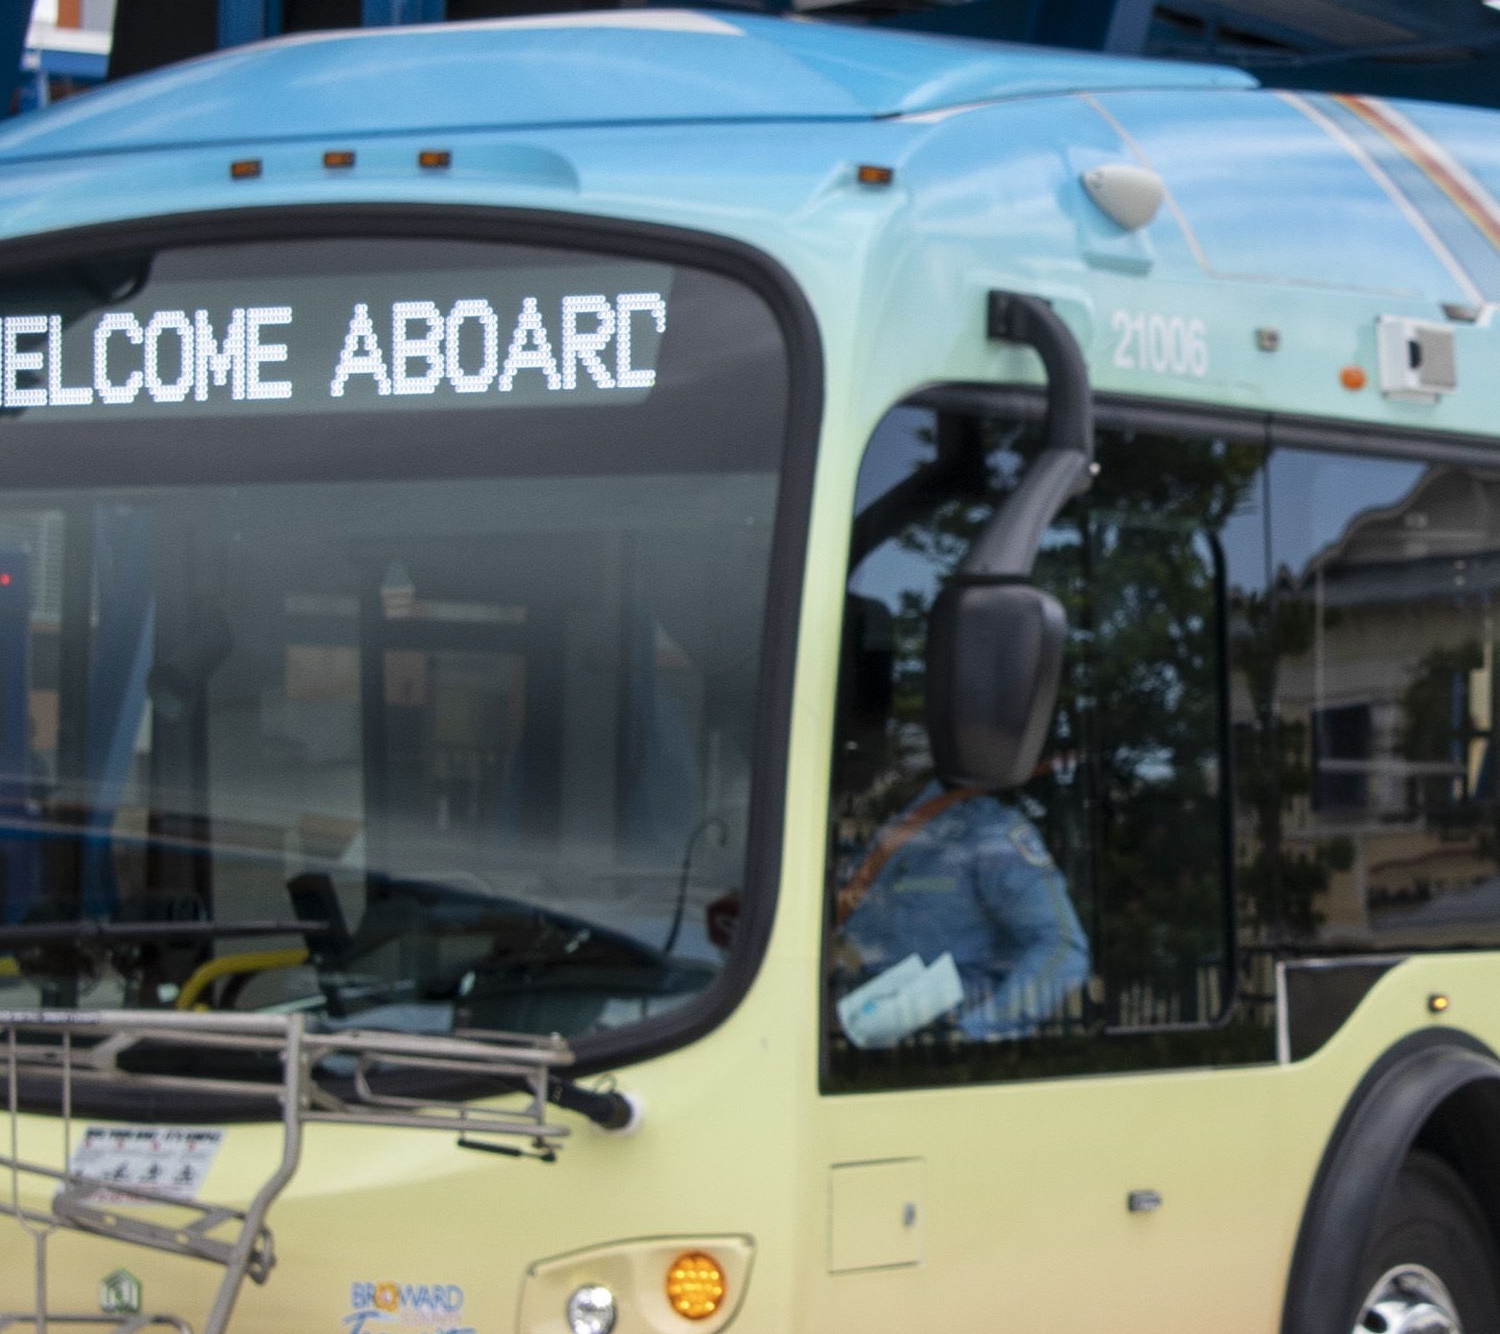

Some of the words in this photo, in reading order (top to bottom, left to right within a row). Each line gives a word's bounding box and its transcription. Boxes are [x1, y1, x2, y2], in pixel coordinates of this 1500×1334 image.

[330, 292, 668, 397] ABOARD
[1111, 310, 1209, 378] 21006
[351, 1281, 465, 1313] BROWARD
